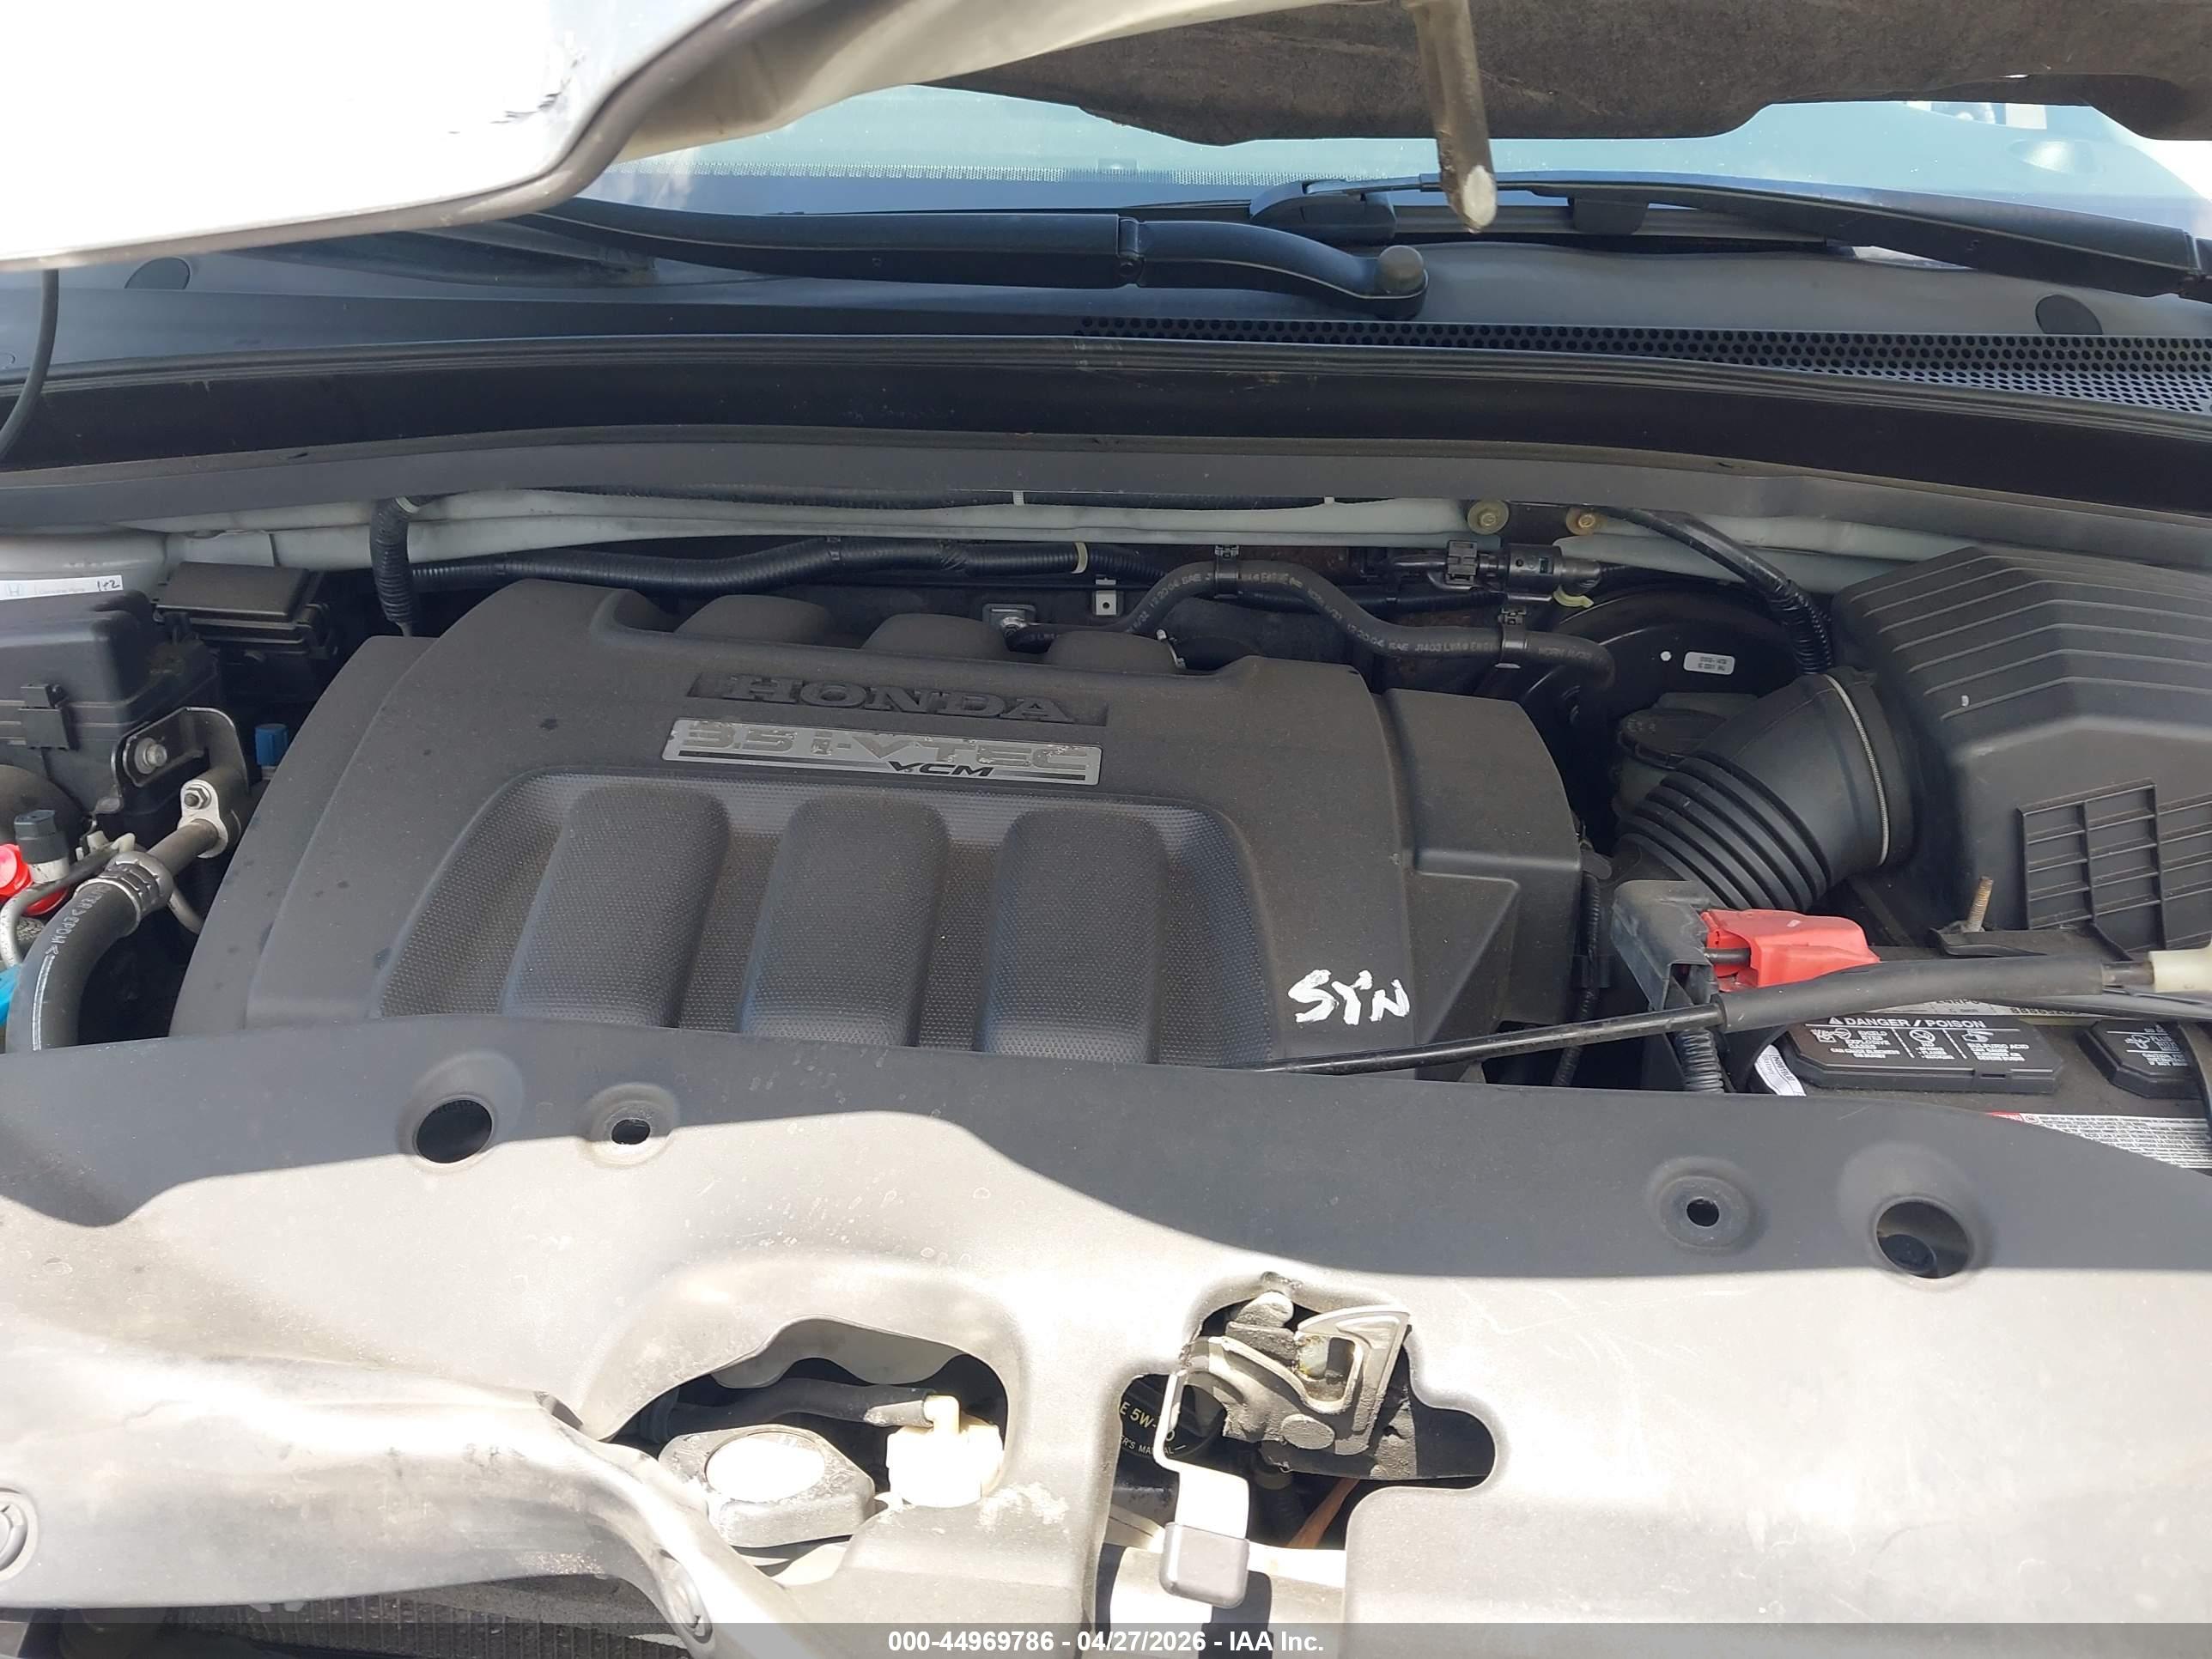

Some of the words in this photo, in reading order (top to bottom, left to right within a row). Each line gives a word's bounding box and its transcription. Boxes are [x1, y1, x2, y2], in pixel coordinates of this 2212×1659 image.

[722, 675, 1075, 723] HONDA
[682, 720, 798, 753] 3.5
[811, 733, 1089, 771] i-VTEC
[886, 760, 995, 777] VCM
[1288, 969, 1410, 1025] SYN
[1844, 1018, 1911, 1027] DANGER
